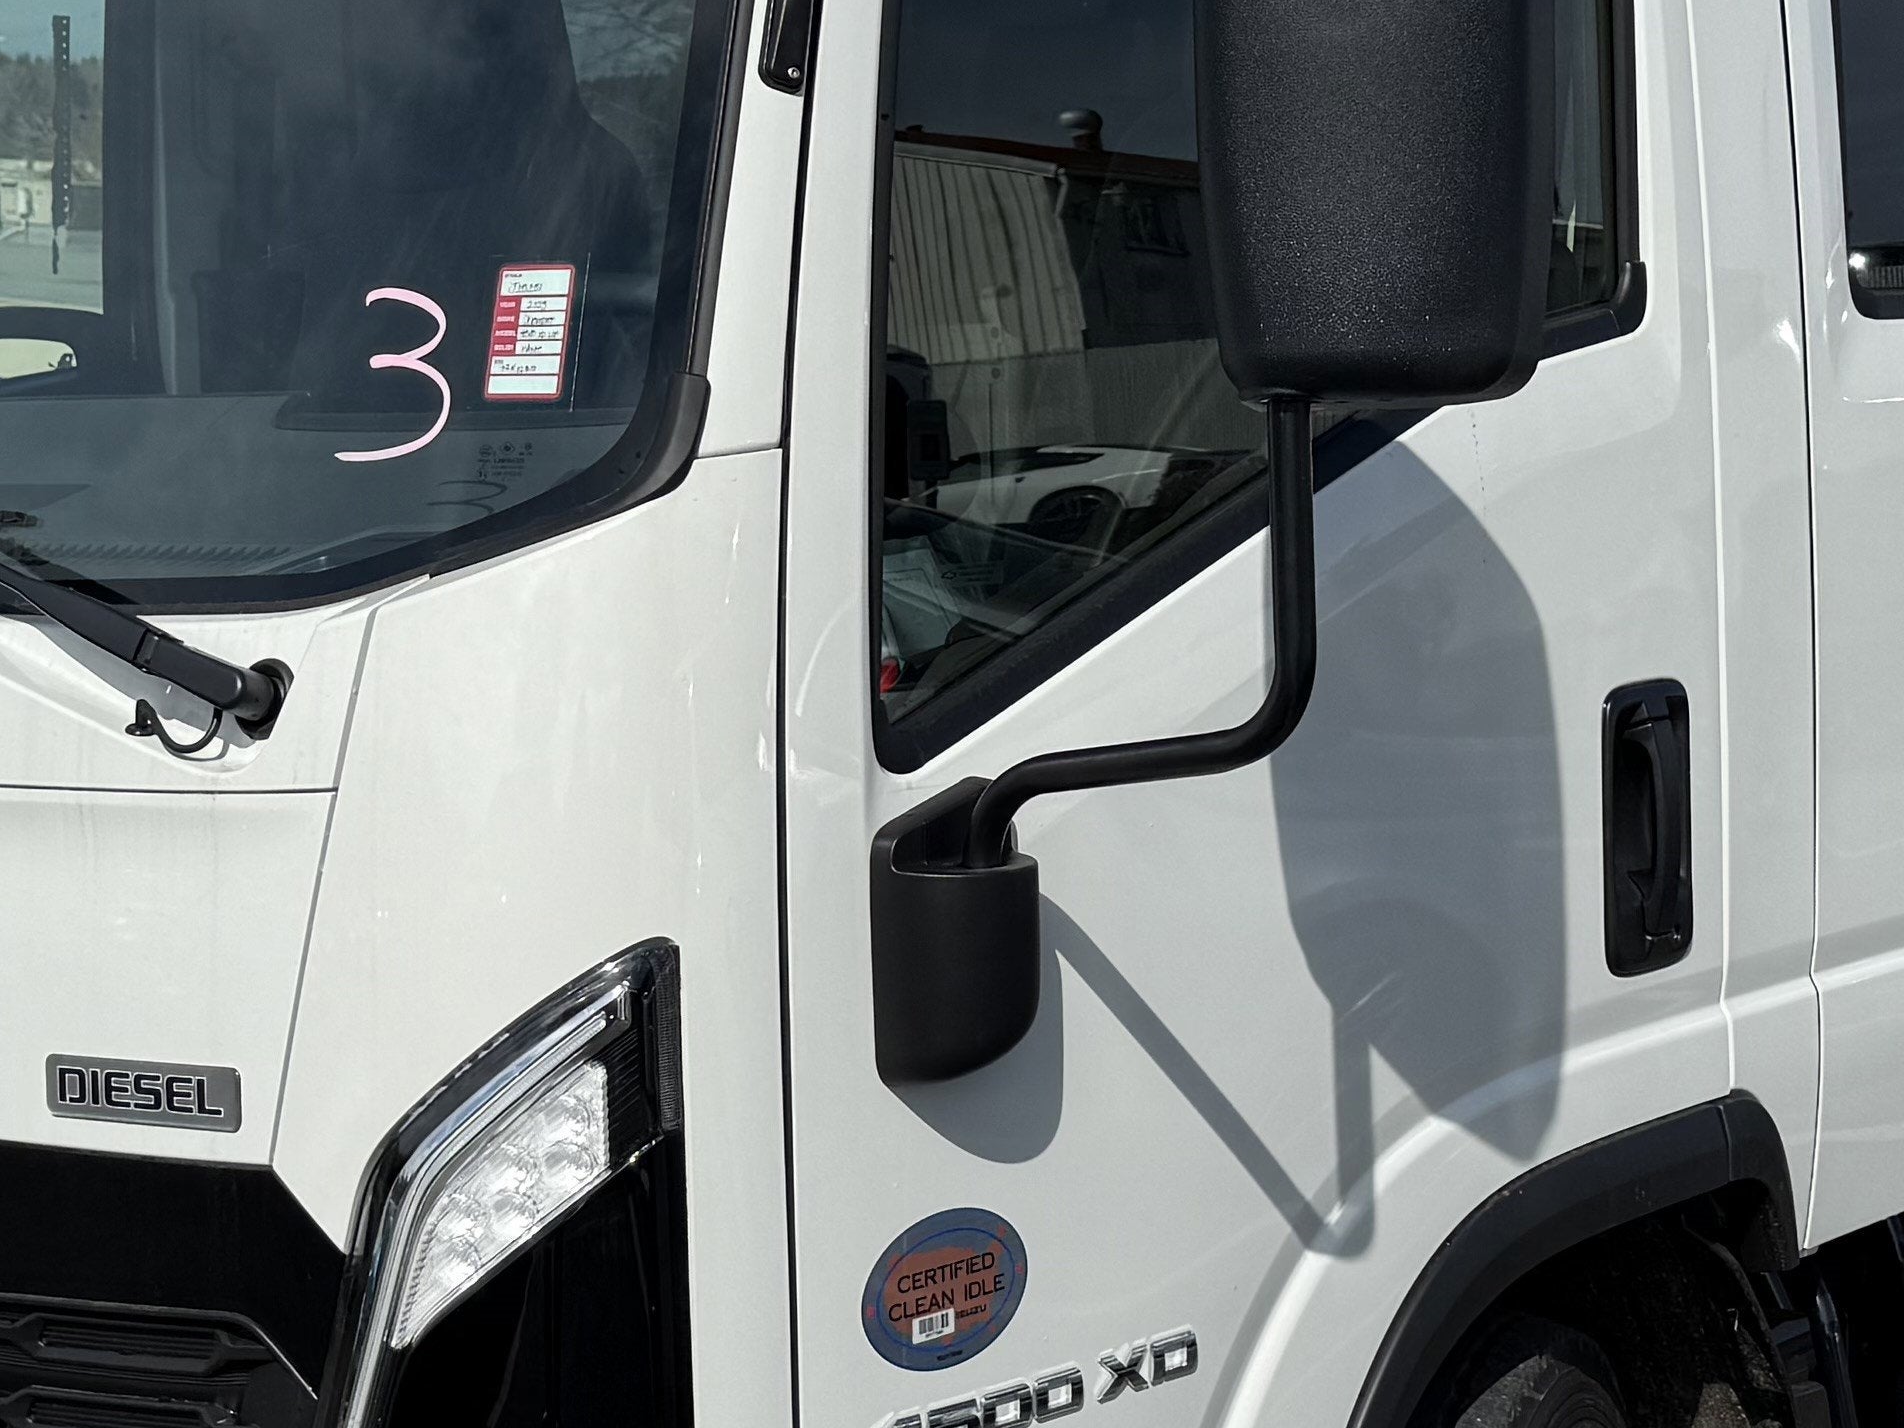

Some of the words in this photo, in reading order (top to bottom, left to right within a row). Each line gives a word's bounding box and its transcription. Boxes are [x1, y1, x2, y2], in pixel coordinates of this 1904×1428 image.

[334, 287, 451, 462] 3
[56, 1065, 224, 1118] DIESEL
[888, 1289, 956, 1323] CLEAN
[964, 1273, 1006, 1303] IDLE
[896, 1252, 996, 1295] CERTIFIED
